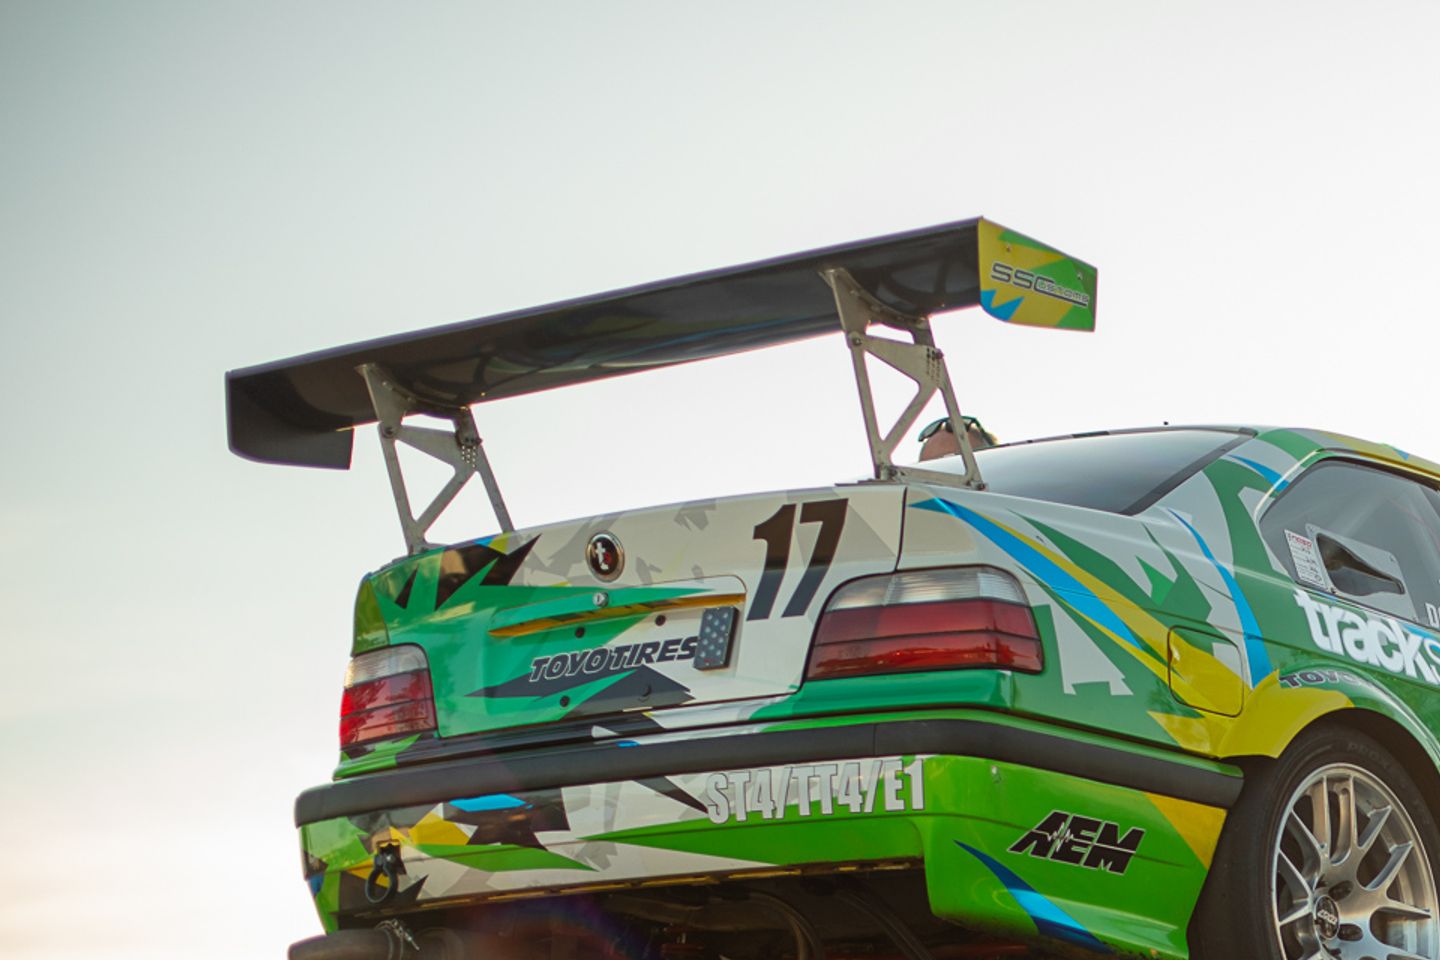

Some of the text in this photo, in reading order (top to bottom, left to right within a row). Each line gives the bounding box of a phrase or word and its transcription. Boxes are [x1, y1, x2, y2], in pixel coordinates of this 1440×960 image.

[746, 498, 849, 621] 17
[705, 758, 925, 825] ST4/TT4/E1
[1006, 809, 1146, 876] AEM
